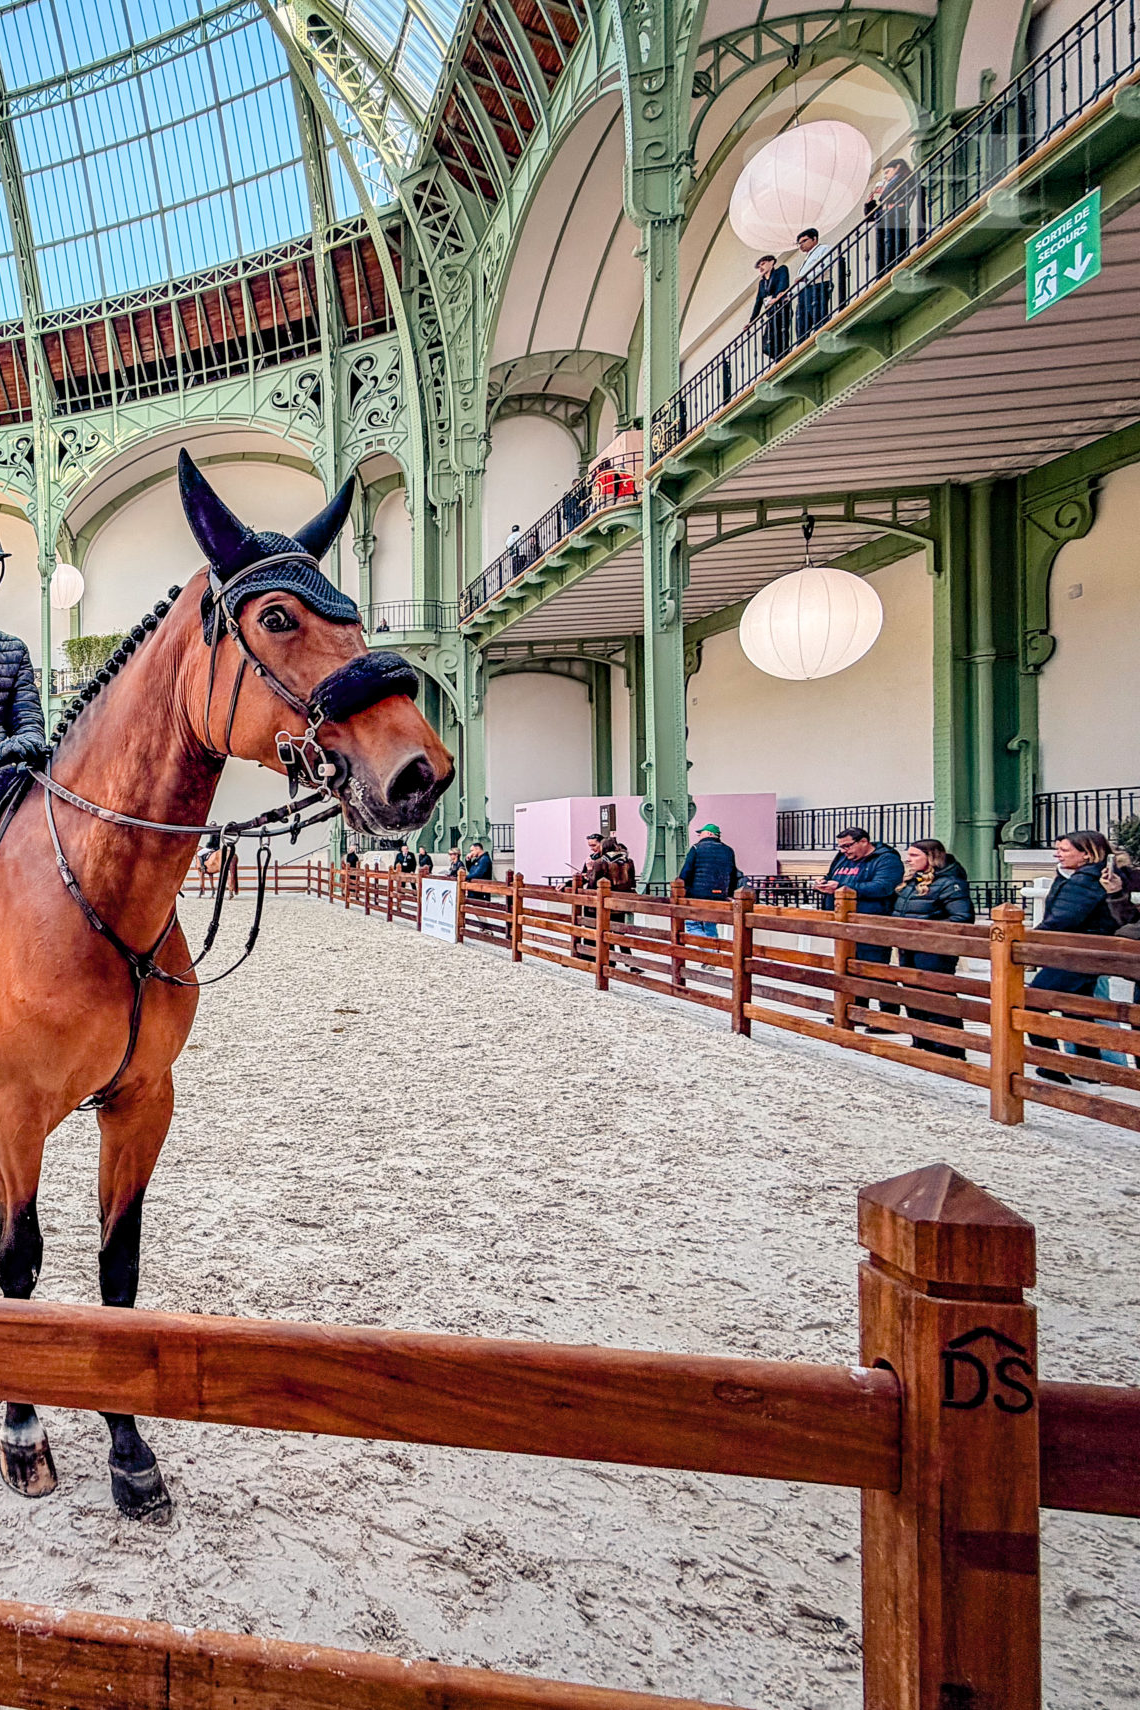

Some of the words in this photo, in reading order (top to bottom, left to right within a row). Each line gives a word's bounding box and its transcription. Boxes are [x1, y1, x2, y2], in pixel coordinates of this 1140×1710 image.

[1035, 219, 1073, 252] SORTIE
[1073, 205, 1090, 225] DE
[1037, 221, 1088, 264] SECOURS
[941, 1351, 1034, 1414] DS
